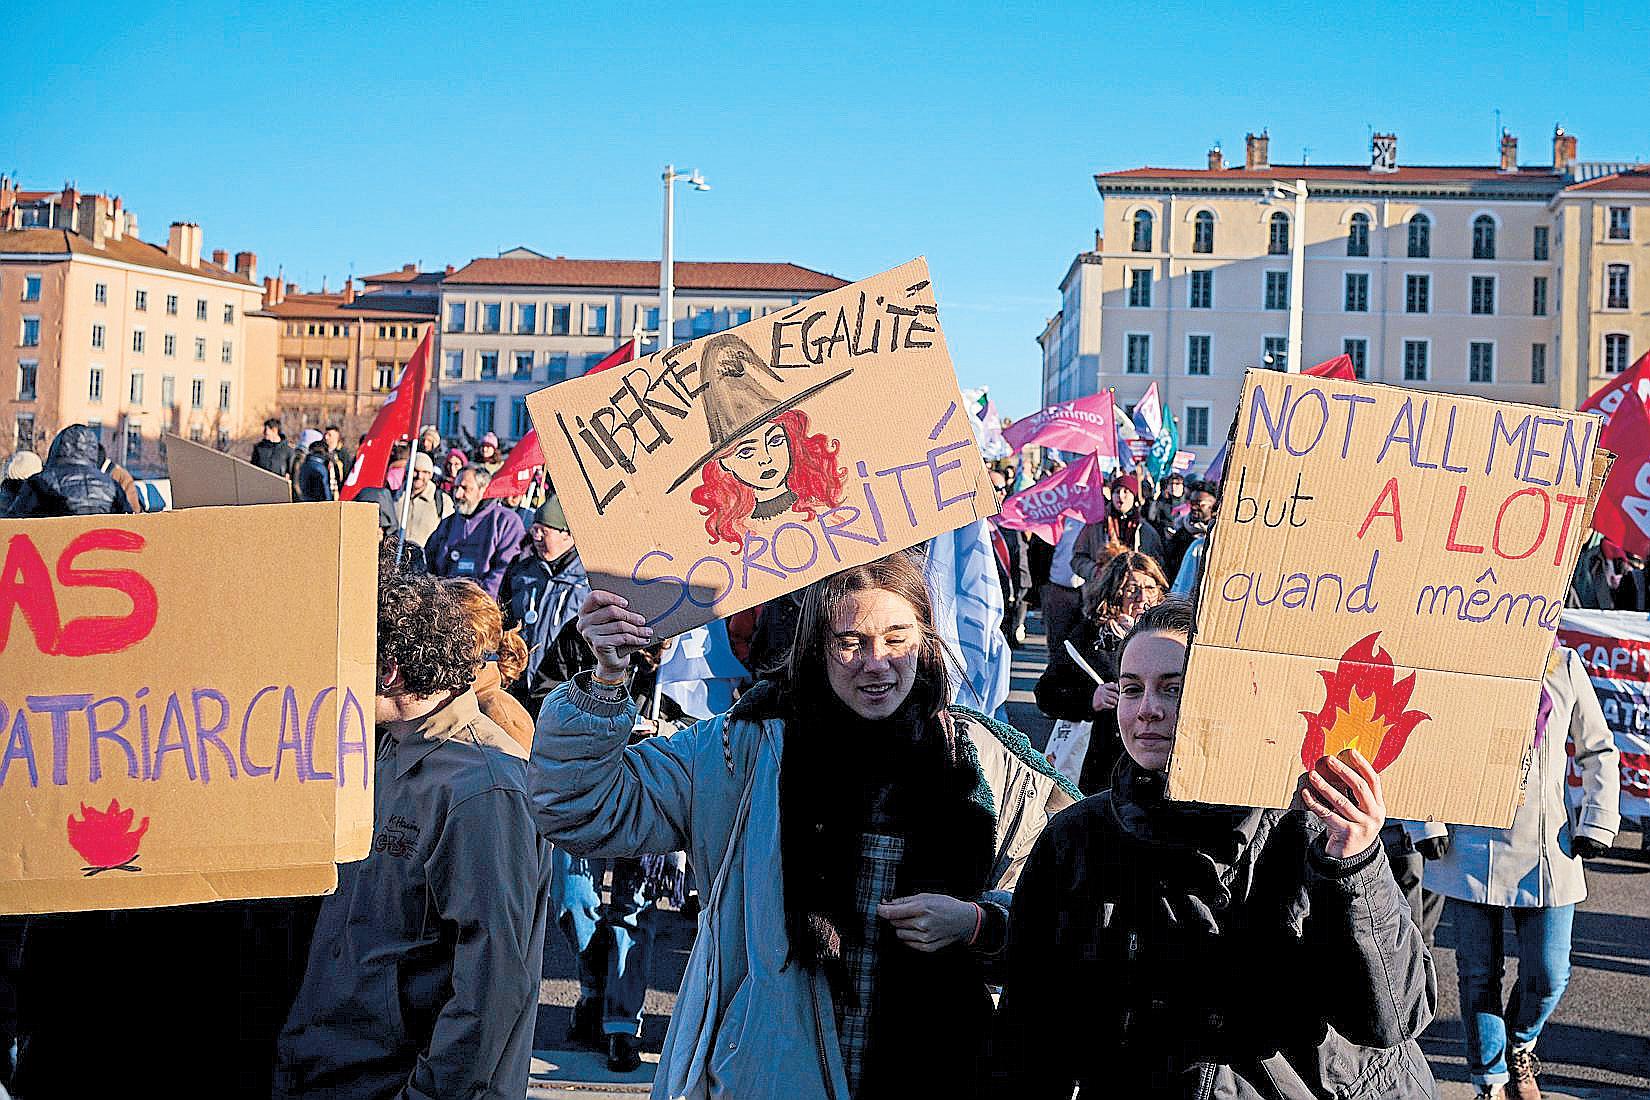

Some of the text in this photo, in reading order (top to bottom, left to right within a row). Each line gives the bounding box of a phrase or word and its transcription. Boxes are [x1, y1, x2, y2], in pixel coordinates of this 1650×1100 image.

[1246, 384, 1593, 487] NOT ALL MEN
[1235, 466, 1313, 528] but
[1357, 477, 1403, 542] A
[1446, 485, 1586, 567] LOT
[0, 528, 158, 657] AS
[1222, 550, 1378, 642] quand
